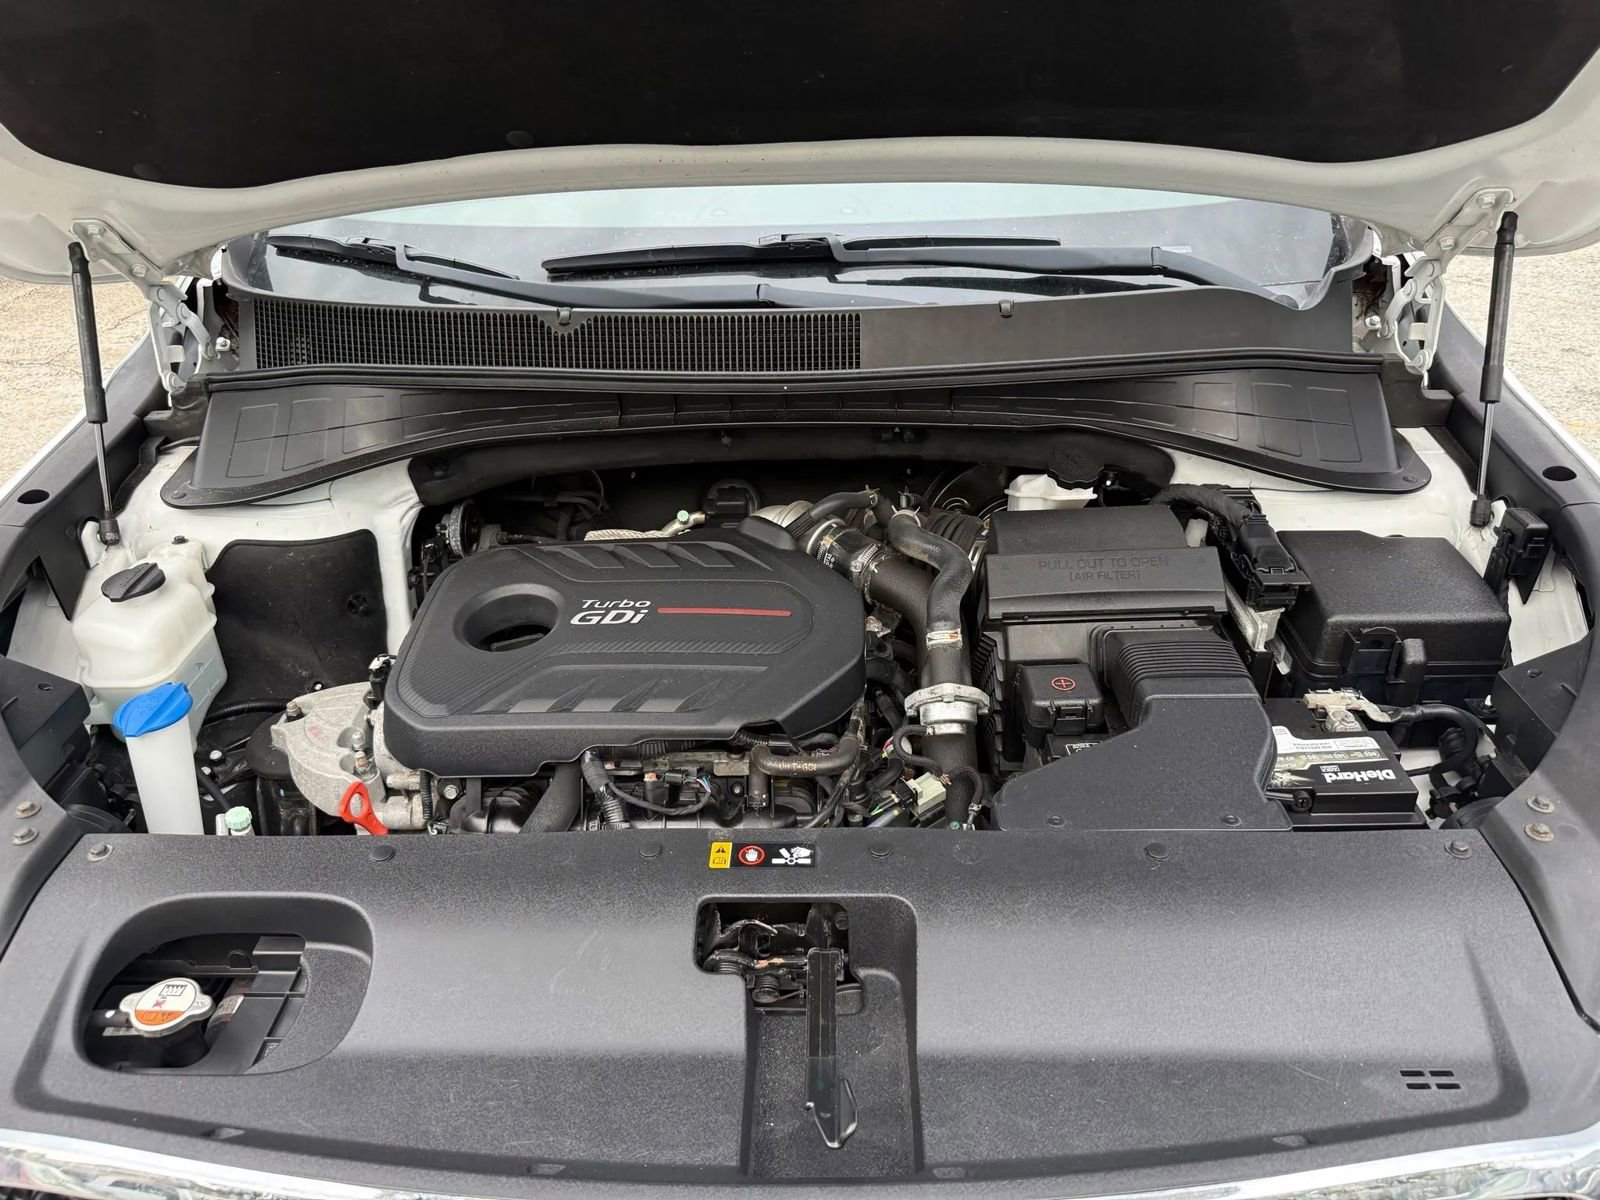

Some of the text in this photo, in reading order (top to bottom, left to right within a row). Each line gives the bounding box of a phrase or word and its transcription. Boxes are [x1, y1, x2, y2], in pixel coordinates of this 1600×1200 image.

[1037, 556, 1170, 570] PULL OUT TO OPEN
[582, 598, 651, 609] Turbo
[570, 609, 649, 624] GDi
[1323, 769, 1397, 783] DieHard
